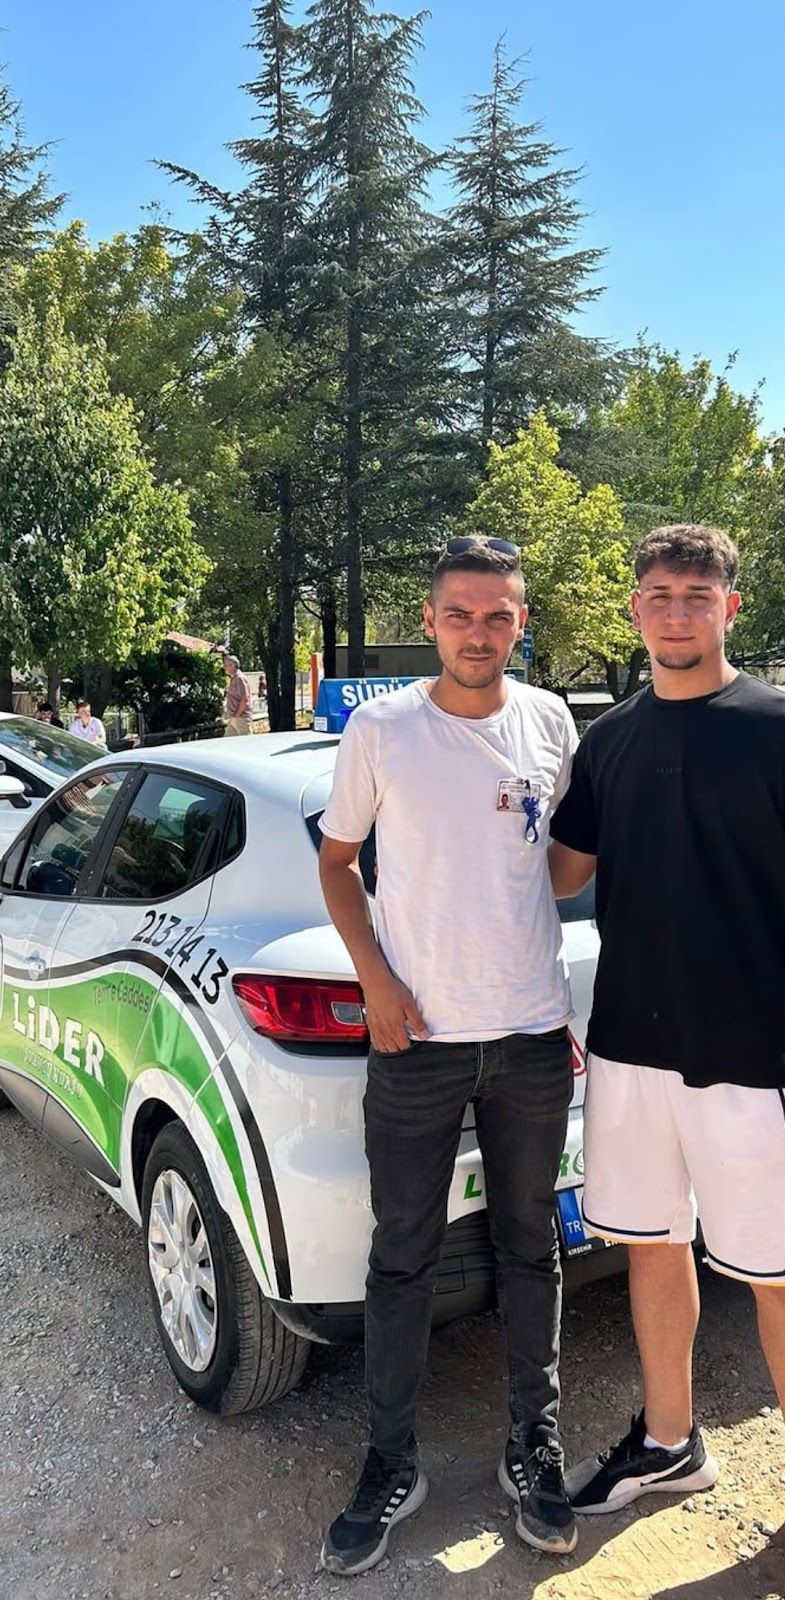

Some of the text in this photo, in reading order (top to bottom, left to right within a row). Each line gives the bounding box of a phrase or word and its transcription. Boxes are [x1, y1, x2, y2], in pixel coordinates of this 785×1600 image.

[131, 909, 229, 1005] 213 14 13
[566, 1220, 582, 1234] TR
